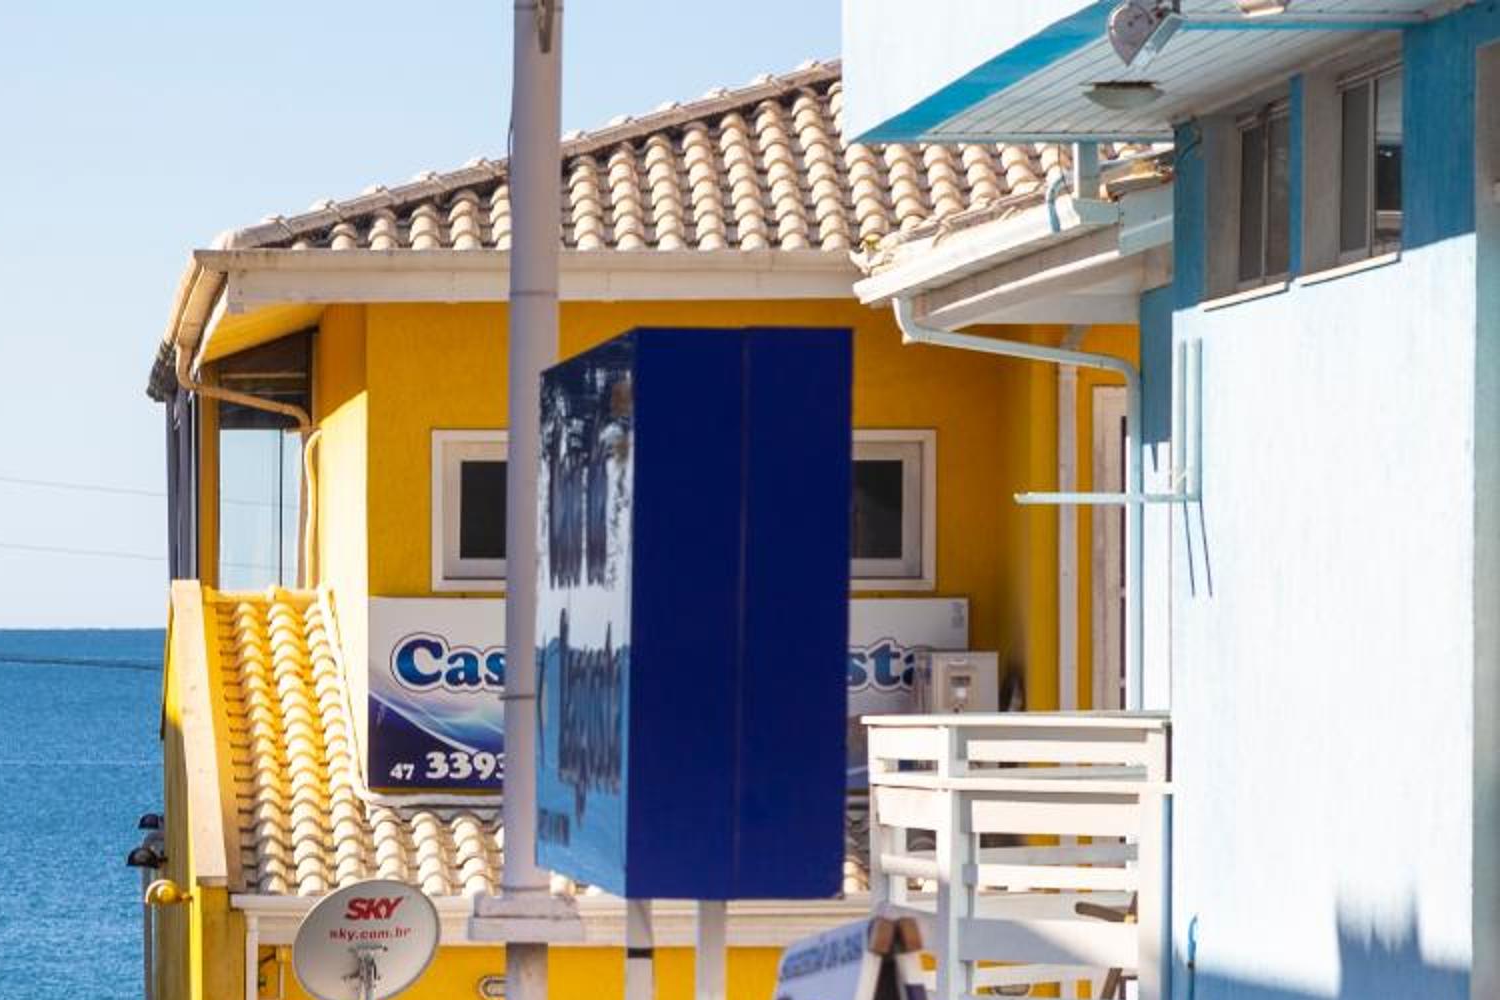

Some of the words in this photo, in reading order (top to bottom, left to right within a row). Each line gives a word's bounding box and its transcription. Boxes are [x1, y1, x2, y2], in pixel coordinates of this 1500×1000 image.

[389, 762, 415, 780] 47
[345, 896, 404, 921] SKY
[329, 926, 412, 943] sky.com.br
